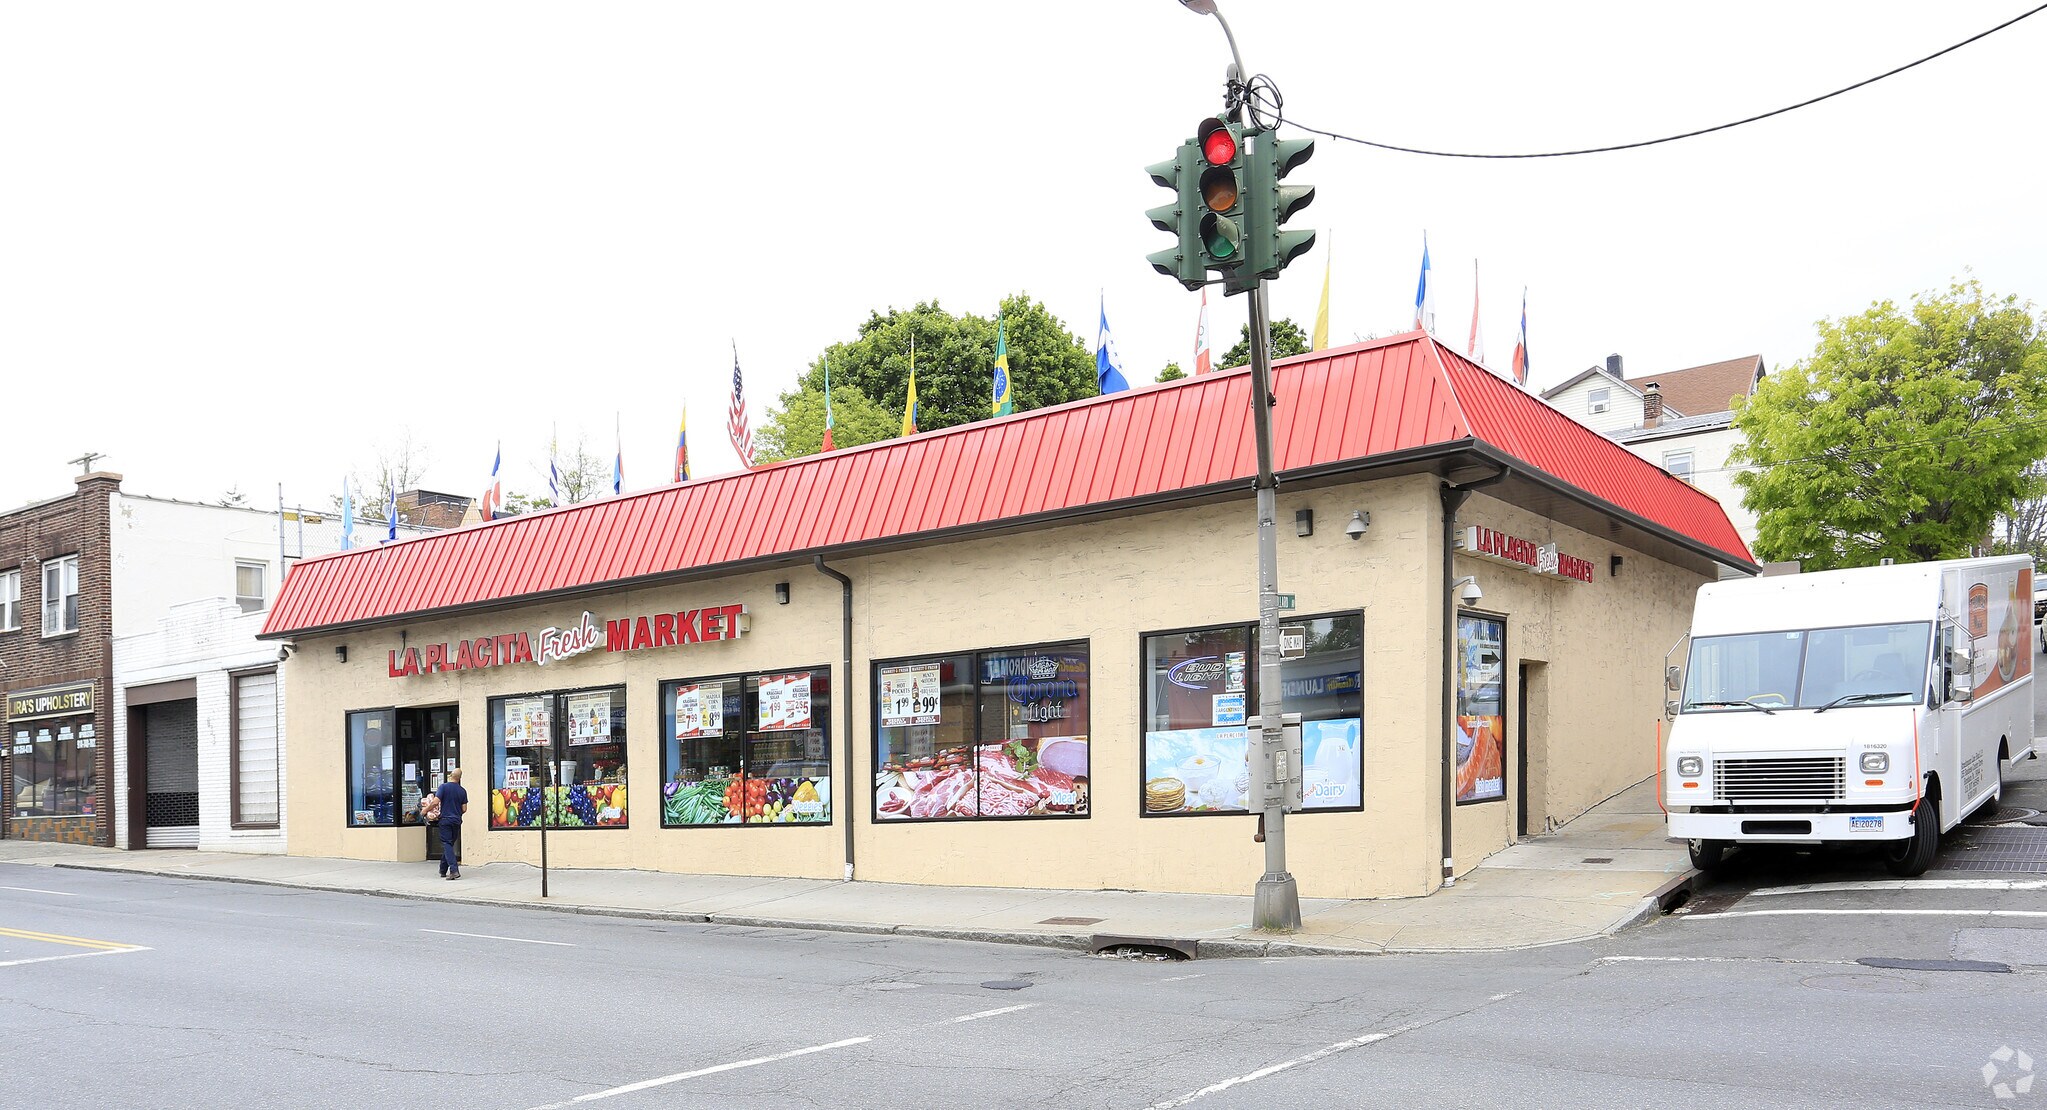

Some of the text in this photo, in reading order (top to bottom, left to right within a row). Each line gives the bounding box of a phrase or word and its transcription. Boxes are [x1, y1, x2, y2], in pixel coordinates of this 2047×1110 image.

[1476, 525, 1595, 584] LA PLACITA Fresh MARKET
[388, 603, 744, 678] LA PLACITA Fresh MARKET
[1284, 635, 1302, 648] ONE WAY
[1185, 663, 1225, 673] BUD
[1175, 671, 1225, 682] LIGHT
[1008, 676, 1078, 705] Corona
[9, 691, 92, 716] LIRA'S UPHOLSTERY
[1027, 700, 1062, 722] Light
[509, 771, 528, 780] ATM
[1316, 781, 1345, 797] Dairy
[1053, 791, 1076, 804] Meat
[1861, 819, 1882, 828] 20278
